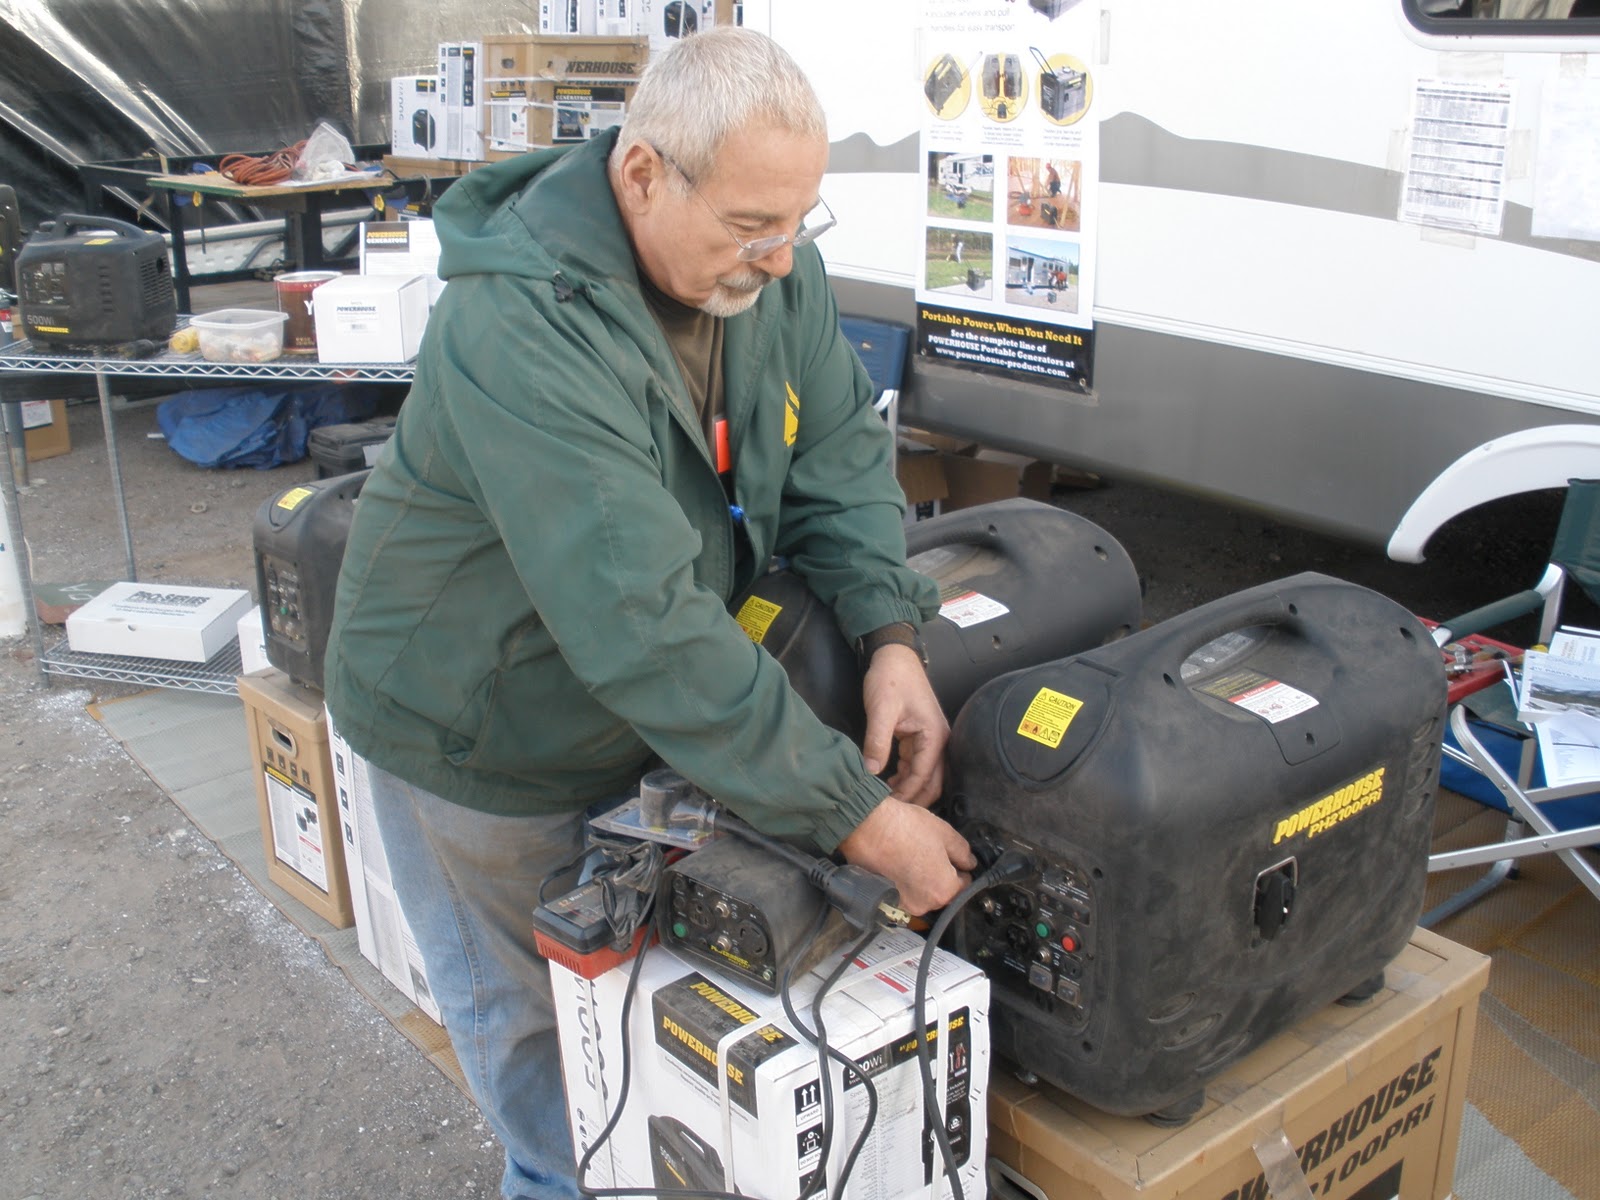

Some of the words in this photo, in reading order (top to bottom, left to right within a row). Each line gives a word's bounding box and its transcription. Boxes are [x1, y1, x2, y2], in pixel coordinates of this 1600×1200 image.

[922, 310, 962, 326] Portable
[963, 317, 996, 332] Power,
[996, 322, 1025, 338] When
[1024, 327, 1043, 340] You
[1045, 330, 1071, 344] Need
[1072, 334, 1083, 346] It
[951, 329, 964, 340] See
[965, 331, 979, 342] the
[980, 334, 1019, 347] complete
[1019, 340, 1036, 350] line
[1037, 343, 1047, 353] of
[928, 334, 980, 352] POWERHOUSE
[980, 344, 1016, 358] Portable
[1017, 350, 1064, 367] Generators
[1065, 360, 1075, 369] at
[1049, 695, 1076, 710] CAUTION
[1273, 767, 1385, 844] POWERHOUSE
[690, 982, 784, 1043] POWERHOSE
[663, 1015, 744, 1086] POWERHOSE
